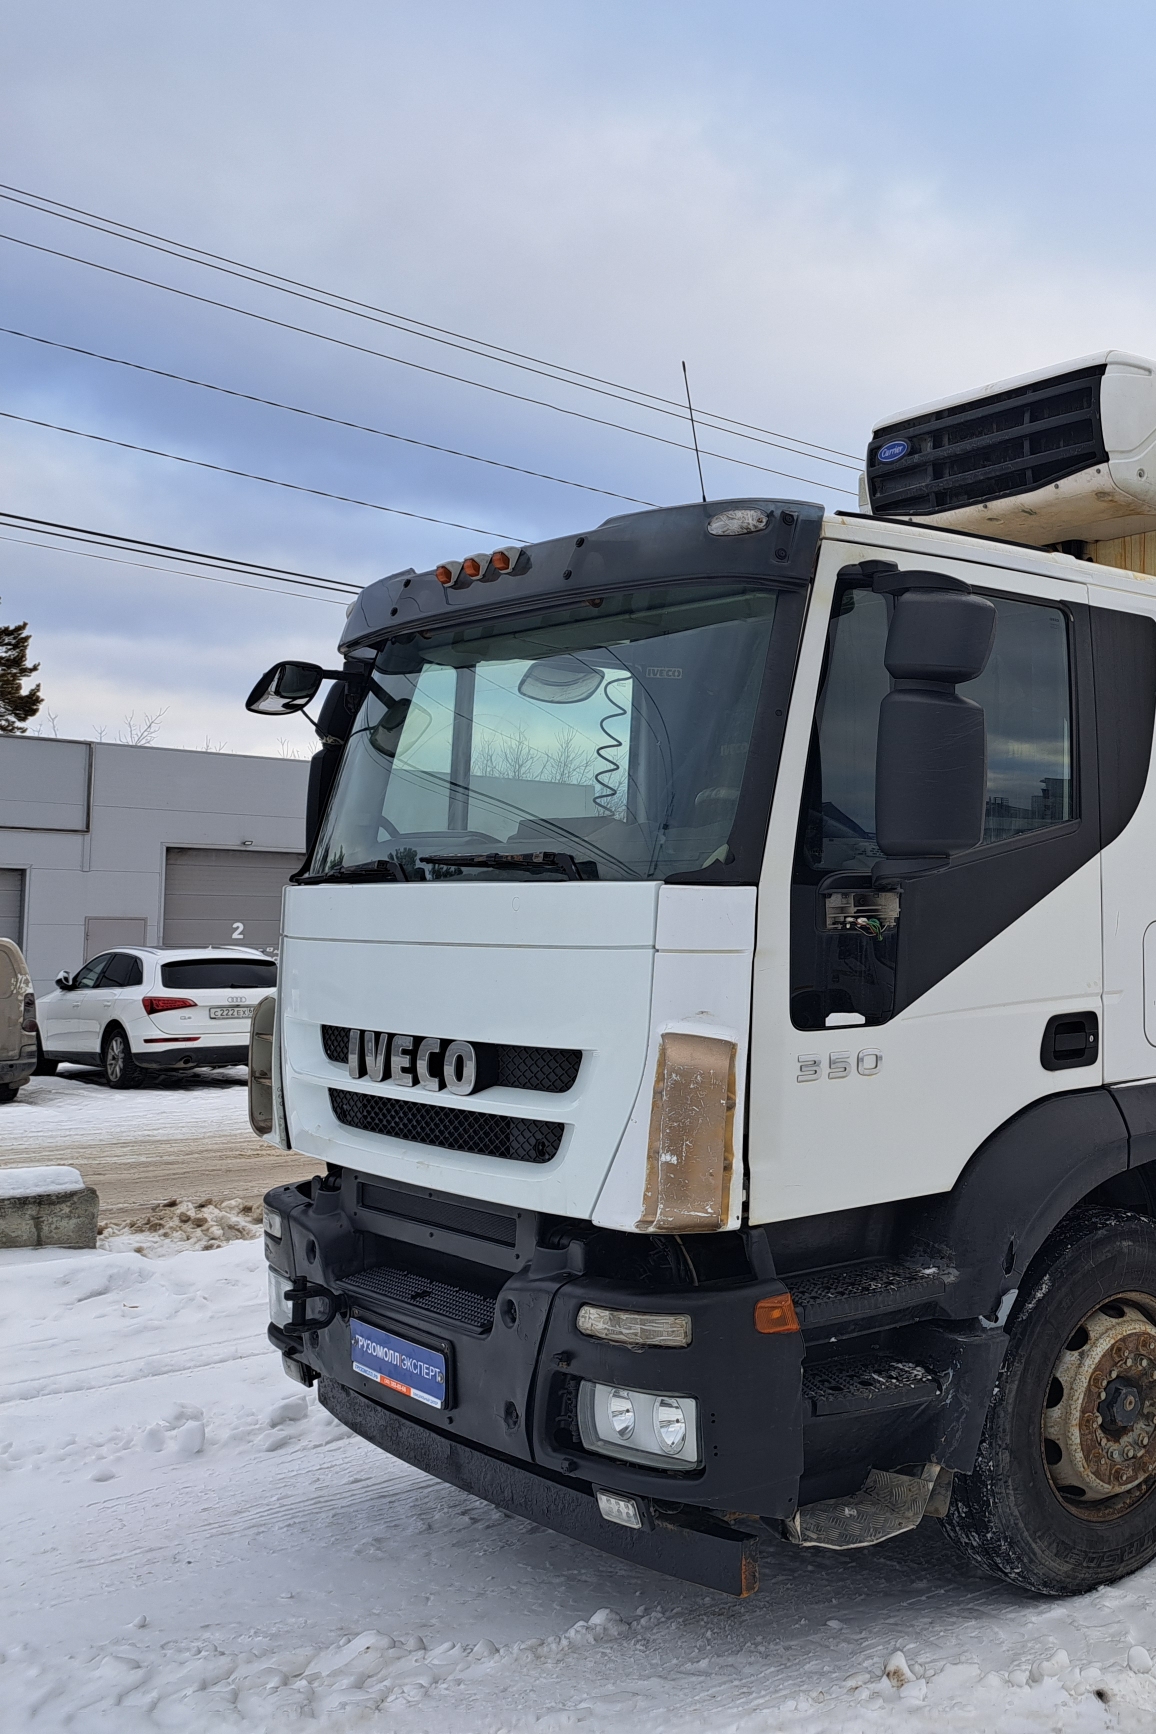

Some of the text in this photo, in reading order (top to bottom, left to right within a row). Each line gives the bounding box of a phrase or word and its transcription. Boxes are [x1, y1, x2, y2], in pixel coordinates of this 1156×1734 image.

[881, 445, 904, 458] Carrier
[647, 668, 681, 678] IVECO
[231, 922, 244, 939] 2
[348, 1029, 477, 1096] IVECO
[796, 1047, 884, 1083] 350
[401, 1354, 441, 1382] ЭКСПЕРТ
